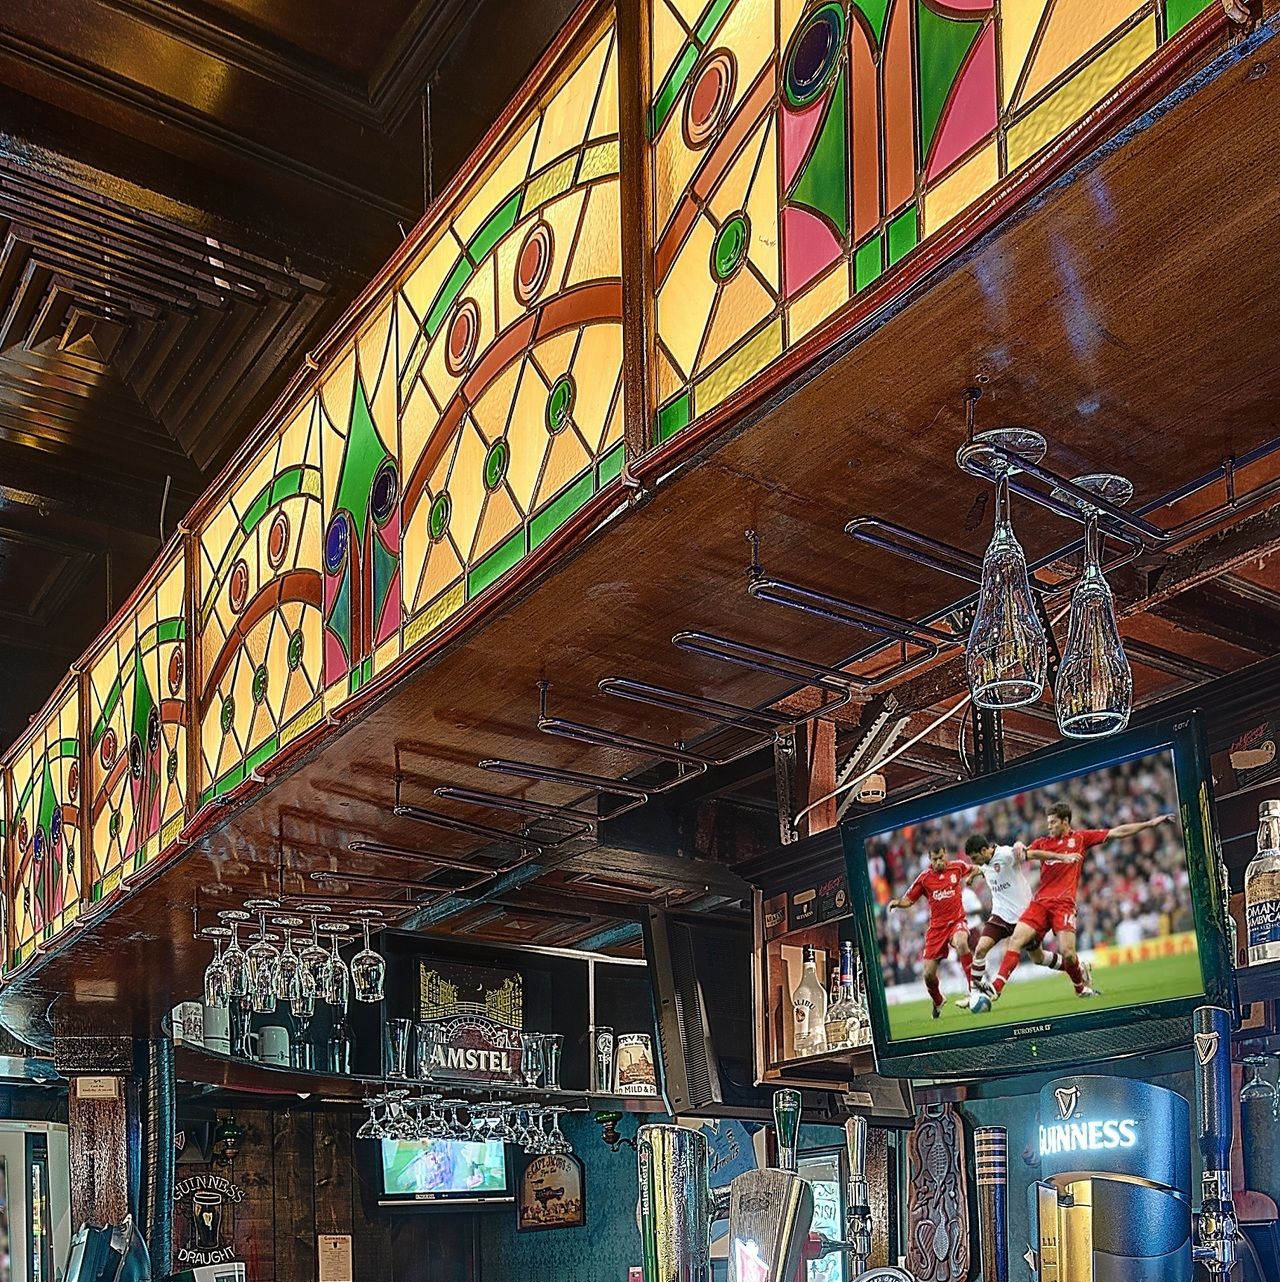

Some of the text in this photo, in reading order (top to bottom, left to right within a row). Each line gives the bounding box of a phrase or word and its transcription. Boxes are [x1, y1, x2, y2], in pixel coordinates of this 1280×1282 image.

[1013, 1025, 1044, 1036] EUROSTAR
[430, 1044, 512, 1073] AMSTEL
[173, 1175, 245, 1203] GUINNESS
[642, 1165, 650, 1216] Heineken
[178, 1246, 236, 1265] DRAUGHT
